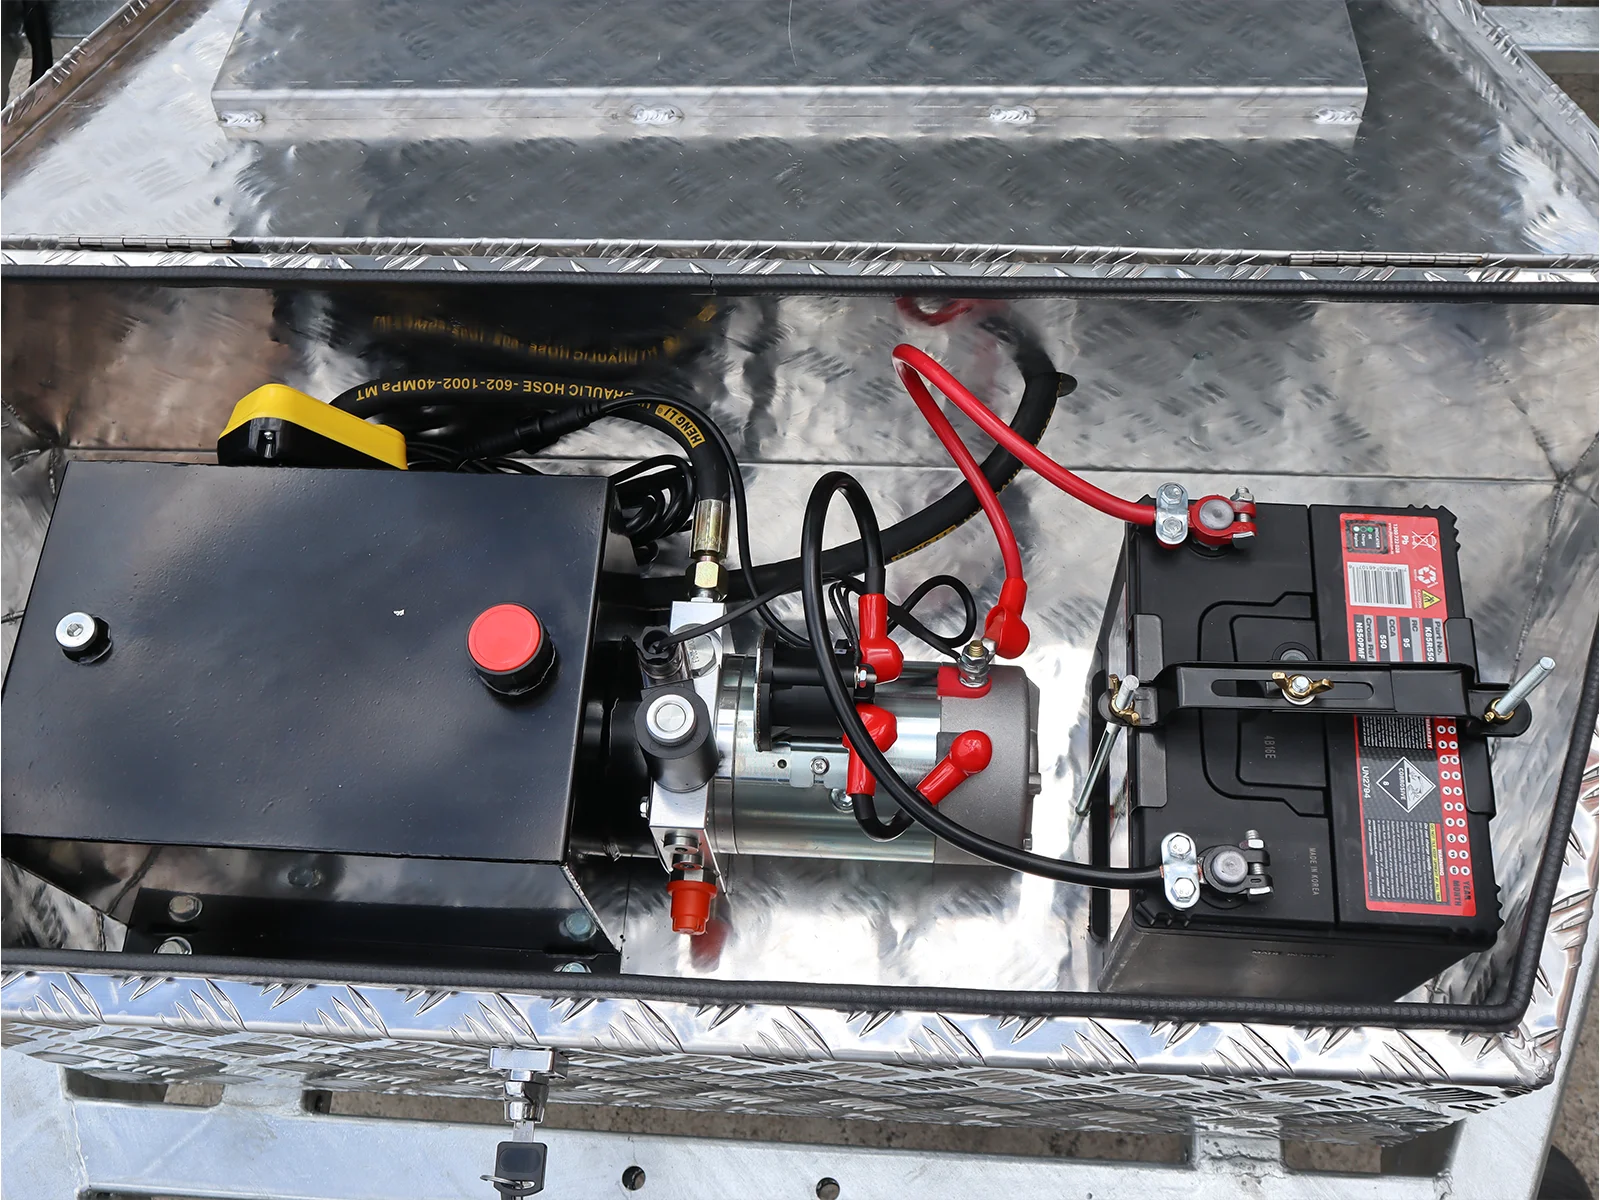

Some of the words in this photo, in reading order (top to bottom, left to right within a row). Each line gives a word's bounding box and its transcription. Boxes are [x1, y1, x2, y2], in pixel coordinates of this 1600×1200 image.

[356, 386, 378, 401] MT
[523, 380, 565, 395] HOSE
[675, 416, 702, 444] HENG
[1402, 535, 1410, 546] Pb
[1411, 620, 1418, 632] RC
[1380, 634, 1388, 649] 550
[1403, 638, 1410, 648] 95
[1362, 766, 1371, 799] UN2794
[1308, 847, 1317, 864] MADE
[1311, 866, 1318, 874] IN
[1312, 875, 1320, 895] KOREA
[1463, 881, 1471, 900] YEAR
[1453, 880, 1462, 906] MONTH
